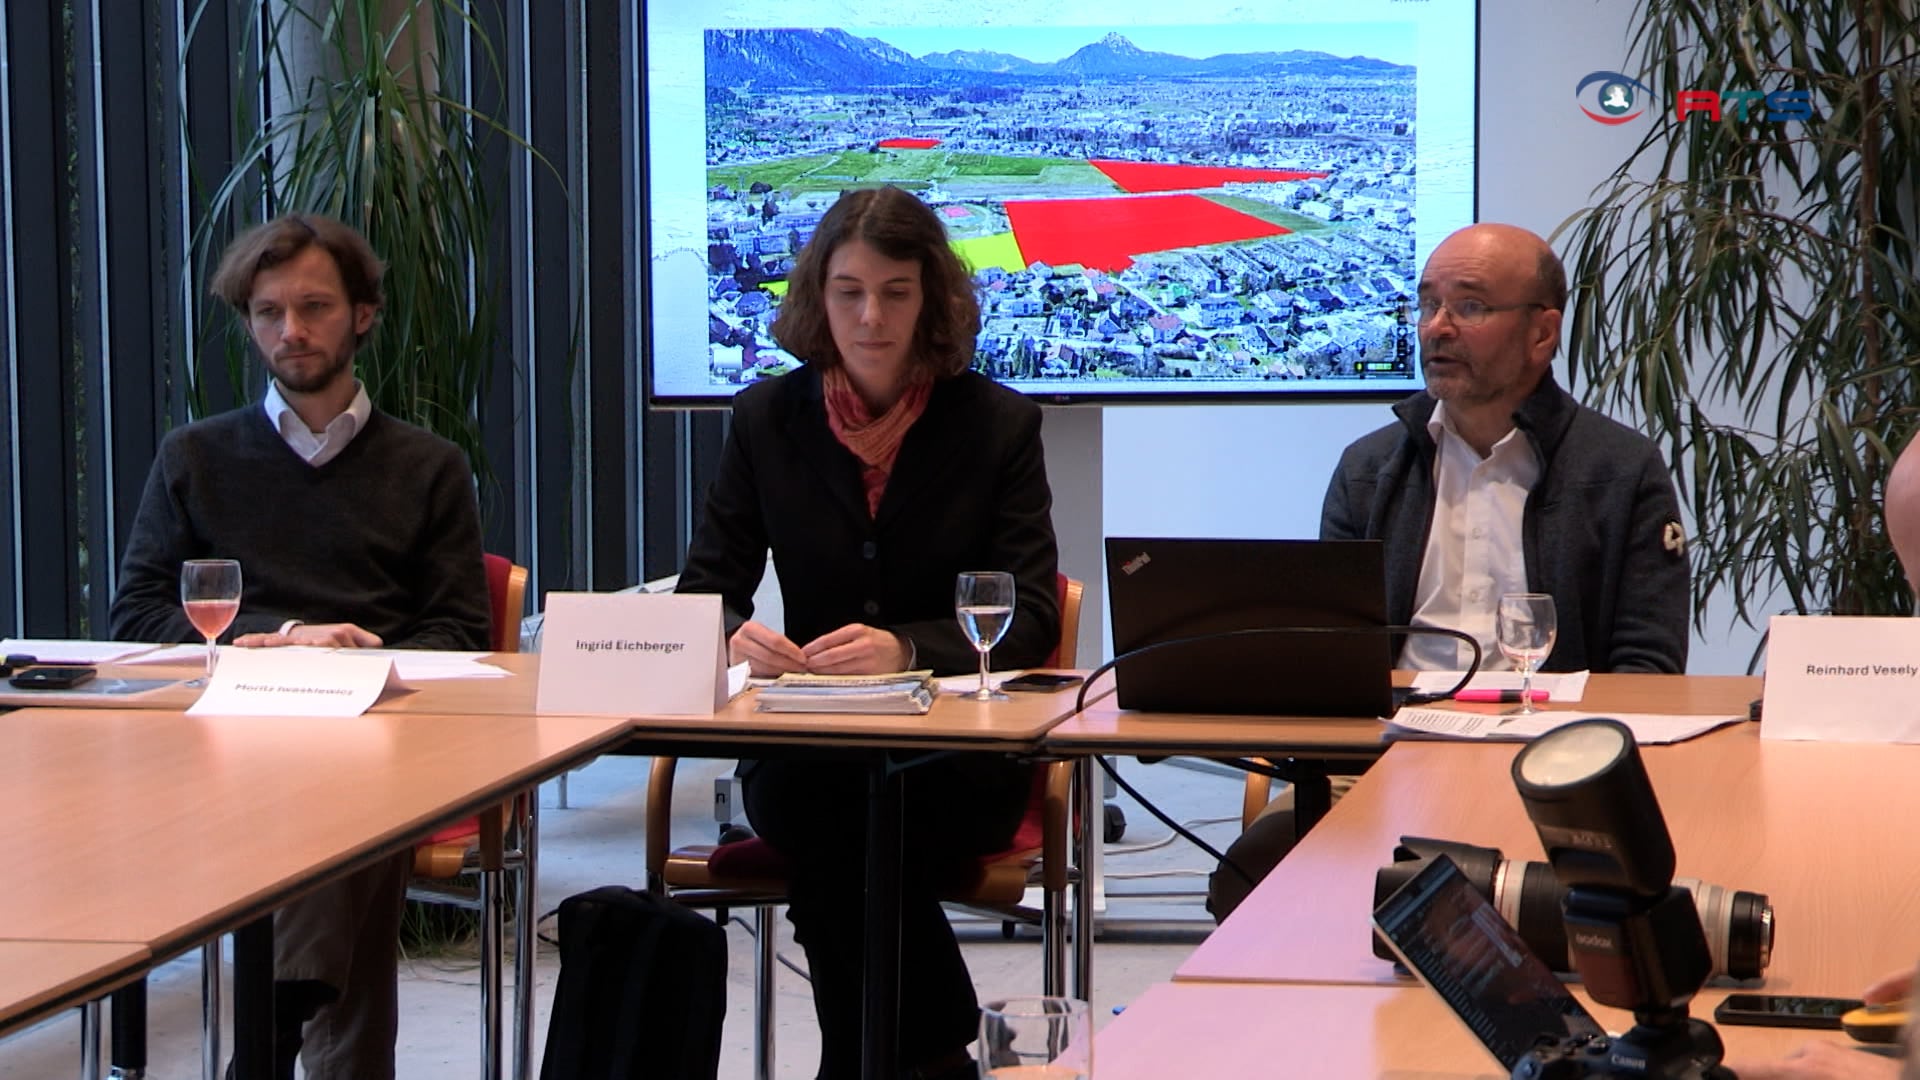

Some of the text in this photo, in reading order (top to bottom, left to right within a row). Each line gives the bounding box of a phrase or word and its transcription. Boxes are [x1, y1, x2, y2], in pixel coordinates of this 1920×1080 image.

[576, 639, 686, 653] Ingrid Eichberger
[1806, 664, 1919, 677] Reinhard Vesely
[234, 683, 274, 693] Moritz
[1611, 1053, 1646, 1070] Canon
